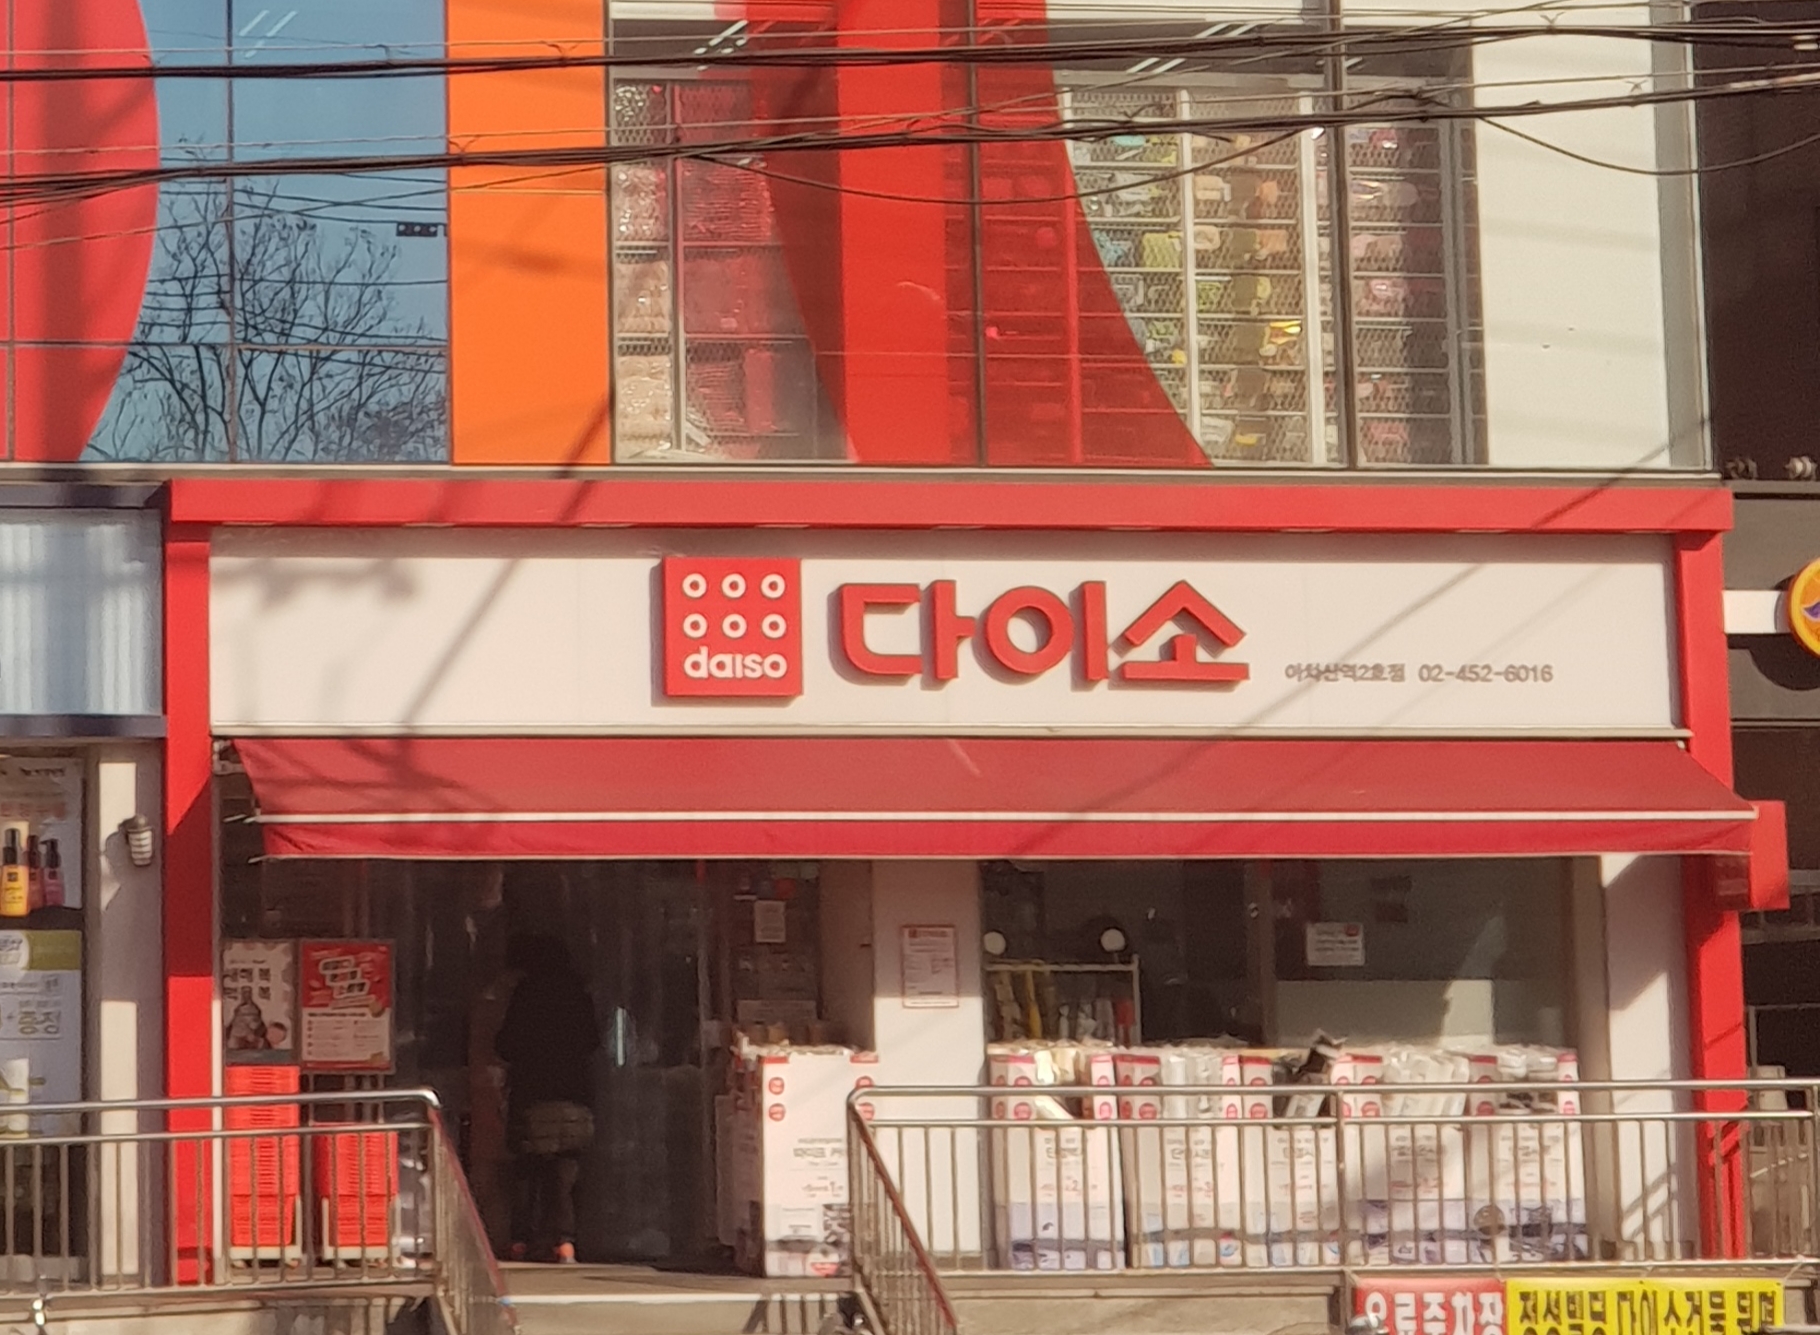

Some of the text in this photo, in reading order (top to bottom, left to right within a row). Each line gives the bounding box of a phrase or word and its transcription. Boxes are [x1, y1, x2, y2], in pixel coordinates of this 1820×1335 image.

[839, 579, 1250, 681] 다이소
[683, 645, 788, 679] daiso
[1418, 663, 1554, 682] 02-452-6016
